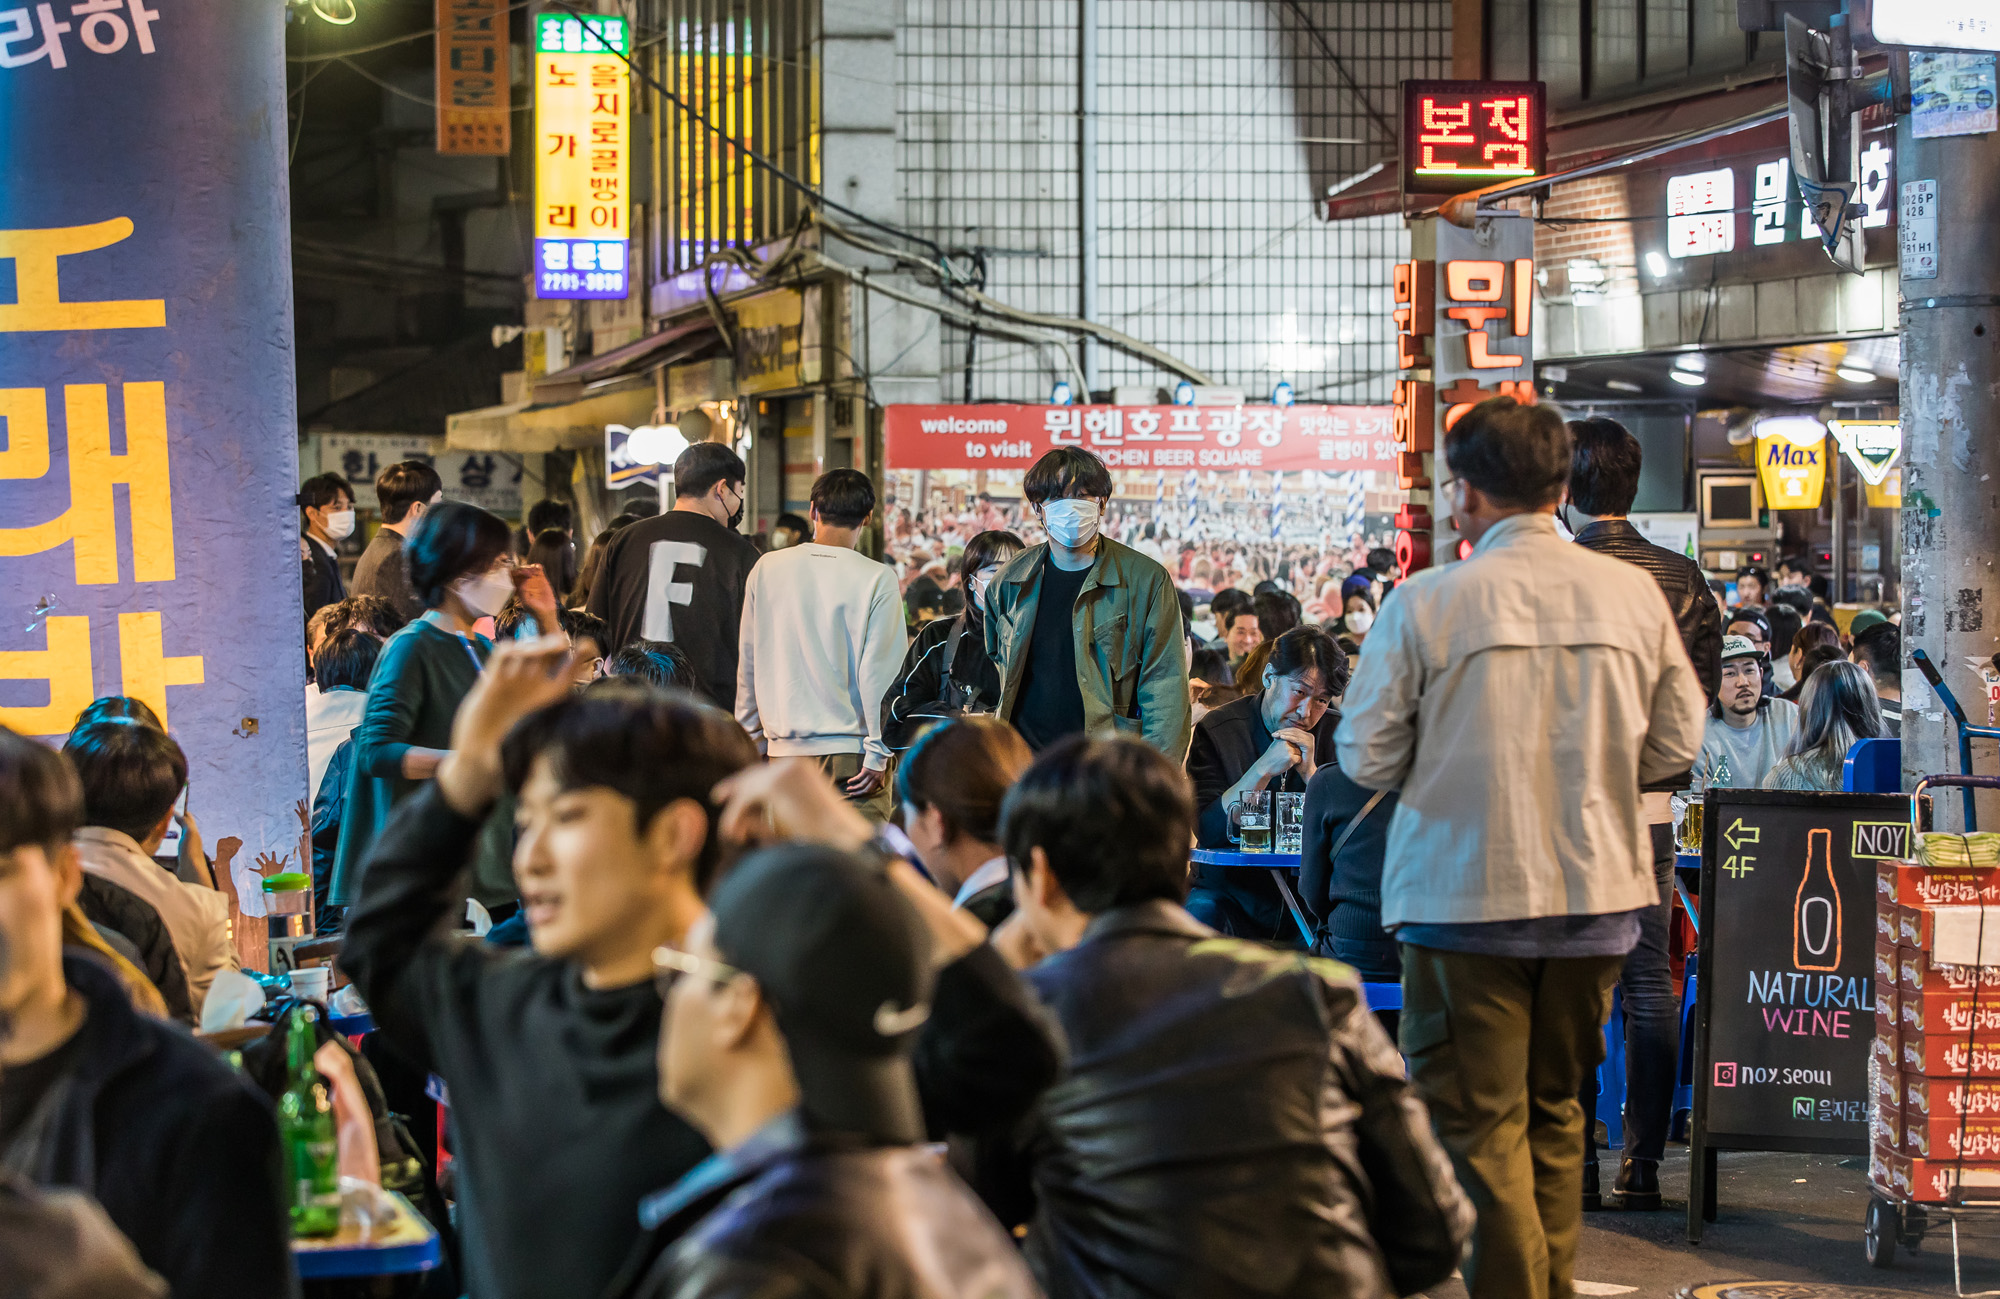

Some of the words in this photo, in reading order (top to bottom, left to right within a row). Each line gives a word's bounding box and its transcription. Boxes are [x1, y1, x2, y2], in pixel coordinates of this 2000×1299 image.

[1420, 97, 1529, 171] 본점
[548, 64, 577, 229] 노가리
[591, 64, 619, 229] 을지로골뱅이
[1906, 205, 1924, 217] 428
[920, 416, 1008, 434] welcome
[1044, 409, 1288, 447] 뮌헨호프광장
[1300, 415, 1350, 436] 맛있는
[965, 440, 986, 458] to
[990, 440, 1032, 458] visit
[1091, 448, 1150, 467] NCHEN
[1153, 449, 1194, 466] BEER
[1198, 449, 1263, 466] SQUARE
[1318, 440, 1368, 461] 골뱅이
[1767, 443, 1818, 466] Max
[640, 539, 708, 643] F
[1857, 825, 1905, 856] NOY
[1722, 855, 1757, 879] 4F
[1747, 970, 1875, 1011] NATURAL
[1762, 1007, 1851, 1039] WINE
[1741, 1066, 1832, 1087] noy.seoul
